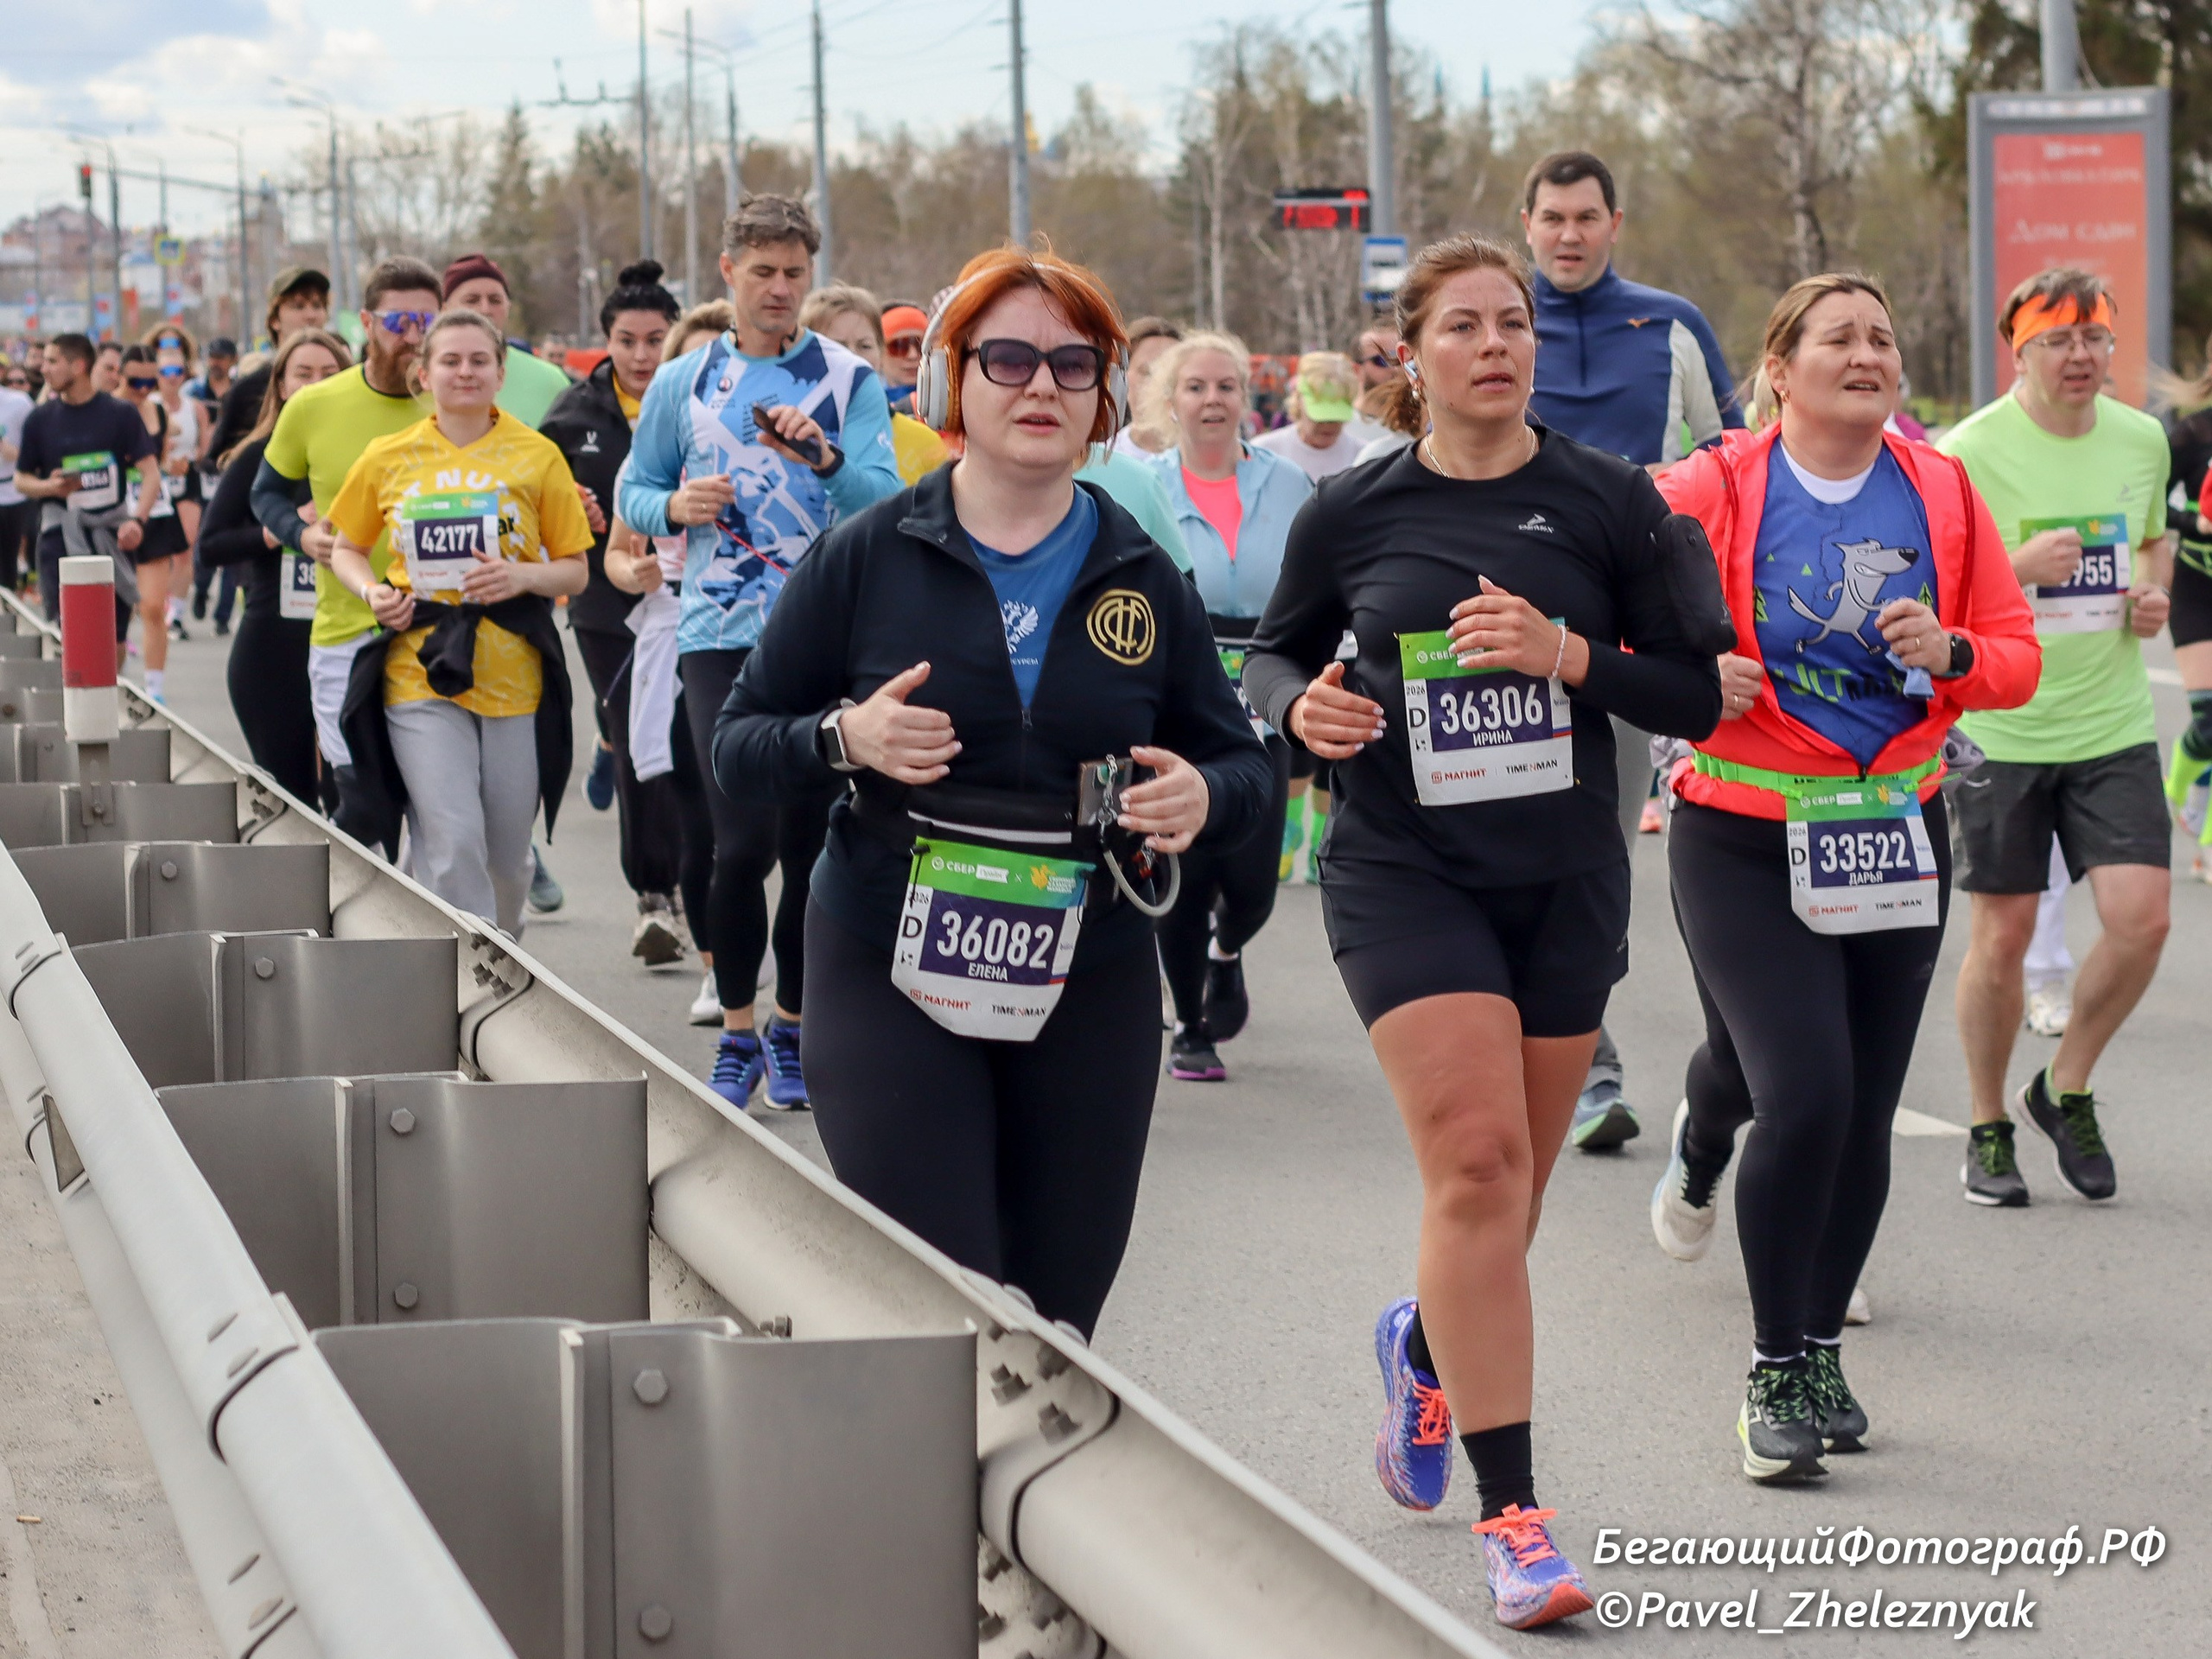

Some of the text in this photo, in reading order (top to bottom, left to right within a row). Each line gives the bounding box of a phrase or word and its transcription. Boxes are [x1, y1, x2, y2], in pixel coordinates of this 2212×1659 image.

[421, 524, 479, 554] 42177
[2061, 554, 2113, 588] 955
[1409, 708, 1427, 728] D
[1440, 683, 1544, 735] 36306
[1472, 729, 1514, 747] ИРИНА
[1444, 768, 1487, 782] МАГНИТ
[1791, 847, 1807, 866] D
[1819, 830, 1911, 874] 33522
[1848, 871, 1884, 887] ДАРЬЯ
[902, 915, 923, 939] D
[937, 910, 1054, 969] 36082
[968, 963, 1008, 982] ЕЛЕНА
[924, 994, 971, 1011] МАГНИТ
